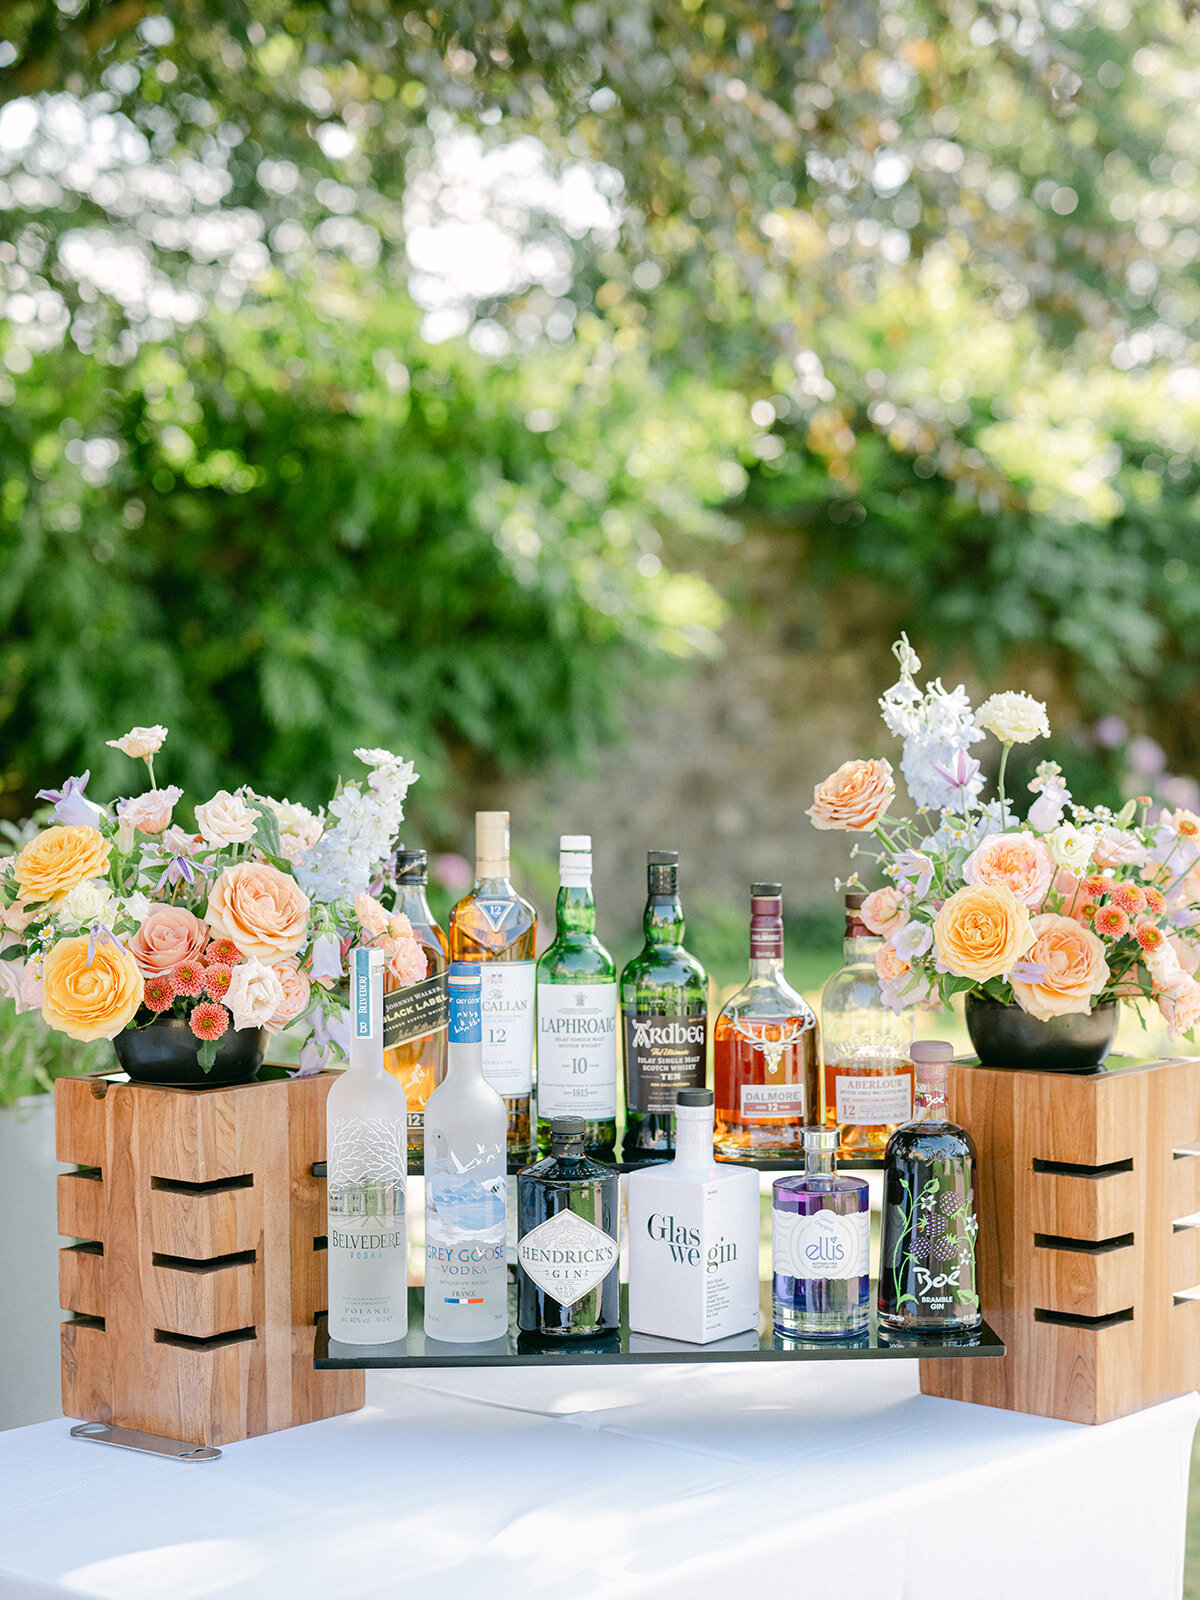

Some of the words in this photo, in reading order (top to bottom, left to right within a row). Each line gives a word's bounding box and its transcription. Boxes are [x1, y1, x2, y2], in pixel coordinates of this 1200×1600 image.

[489, 906, 502, 915] 12
[358, 975, 369, 1015] BELVEDERE
[385, 996, 414, 1012] JOHNNIE
[413, 987, 441, 1001] WALKER
[415, 994, 448, 1011] LABEL
[481, 1000, 528, 1012] CALLAN
[541, 1017, 616, 1034] LAPHROAIG
[489, 1029, 506, 1044] 12
[571, 1057, 588, 1074] 10
[637, 1056, 657, 1064] ISLAY
[684, 1055, 701, 1064] MALT
[642, 1064, 670, 1072] SCOTCH
[670, 1063, 697, 1072] WHISKY
[660, 1072, 682, 1081] TEN
[847, 1080, 903, 1090] ABERLOUR
[571, 1088, 589, 1098] 1815
[745, 1091, 800, 1101] DALMORE
[767, 1103, 779, 1112] 12
[842, 1104, 856, 1116] 12
[407, 1113, 421, 1126] 12
[647, 1213, 701, 1248] Glas
[332, 1229, 401, 1250] BELVEDERE
[426, 1244, 454, 1262] GREY
[458, 1244, 505, 1263] GOOSE
[805, 1235, 845, 1261] ellis
[349, 1251, 384, 1260] VODKA
[522, 1245, 614, 1264] HENDRICK'S
[668, 1243, 701, 1267] we
[706, 1236, 738, 1274] gin
[440, 1264, 488, 1276] VODKA
[551, 1269, 583, 1279] GIN
[344, 1307, 390, 1315] POLAND
[930, 1303, 945, 1311] GIN
